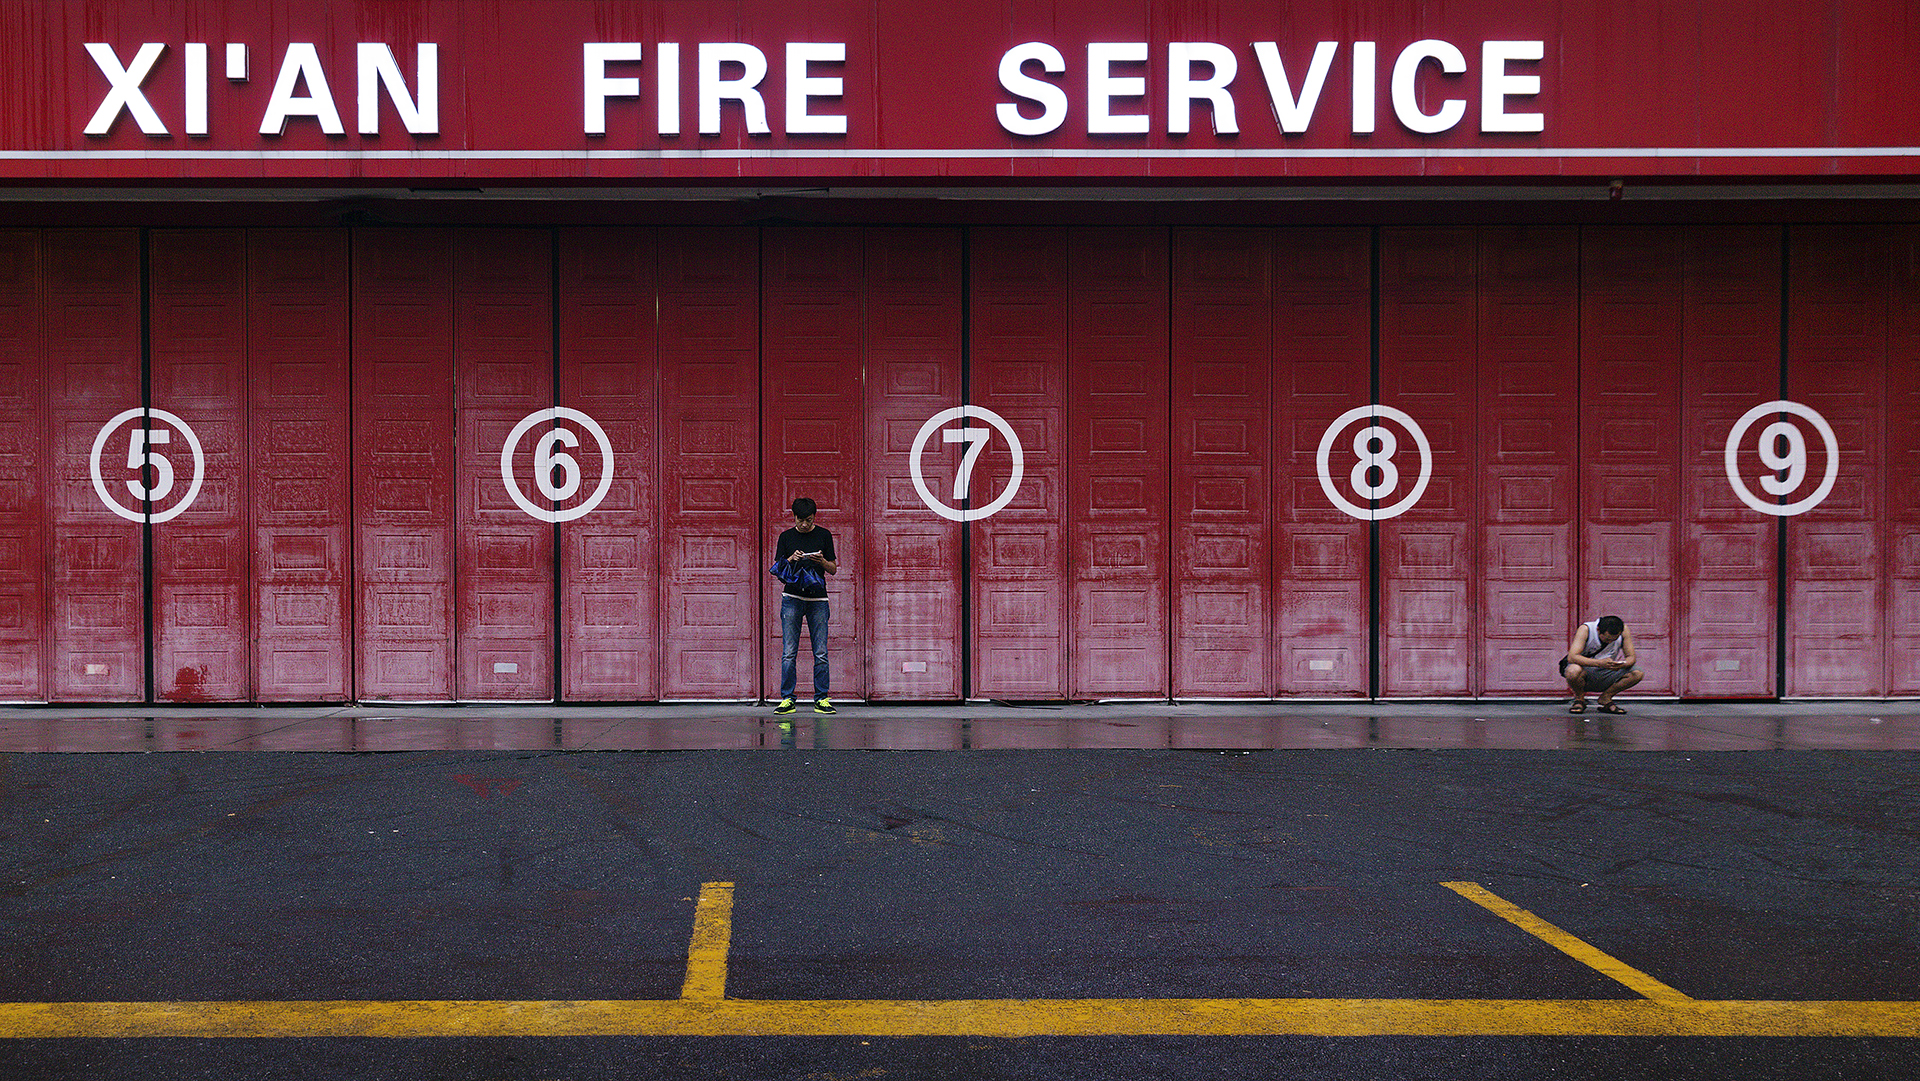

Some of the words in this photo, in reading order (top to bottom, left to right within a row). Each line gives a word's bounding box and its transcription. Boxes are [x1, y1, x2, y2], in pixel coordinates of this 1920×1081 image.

[84, 42, 440, 135] XI'AN
[583, 42, 848, 135] FIRE
[996, 40, 1546, 136] SERVICE
[126, 429, 174, 502] 5
[534, 428, 581, 501] 6
[943, 428, 990, 500] 7
[1350, 426, 1399, 500] 8
[1758, 422, 1807, 496] 9
